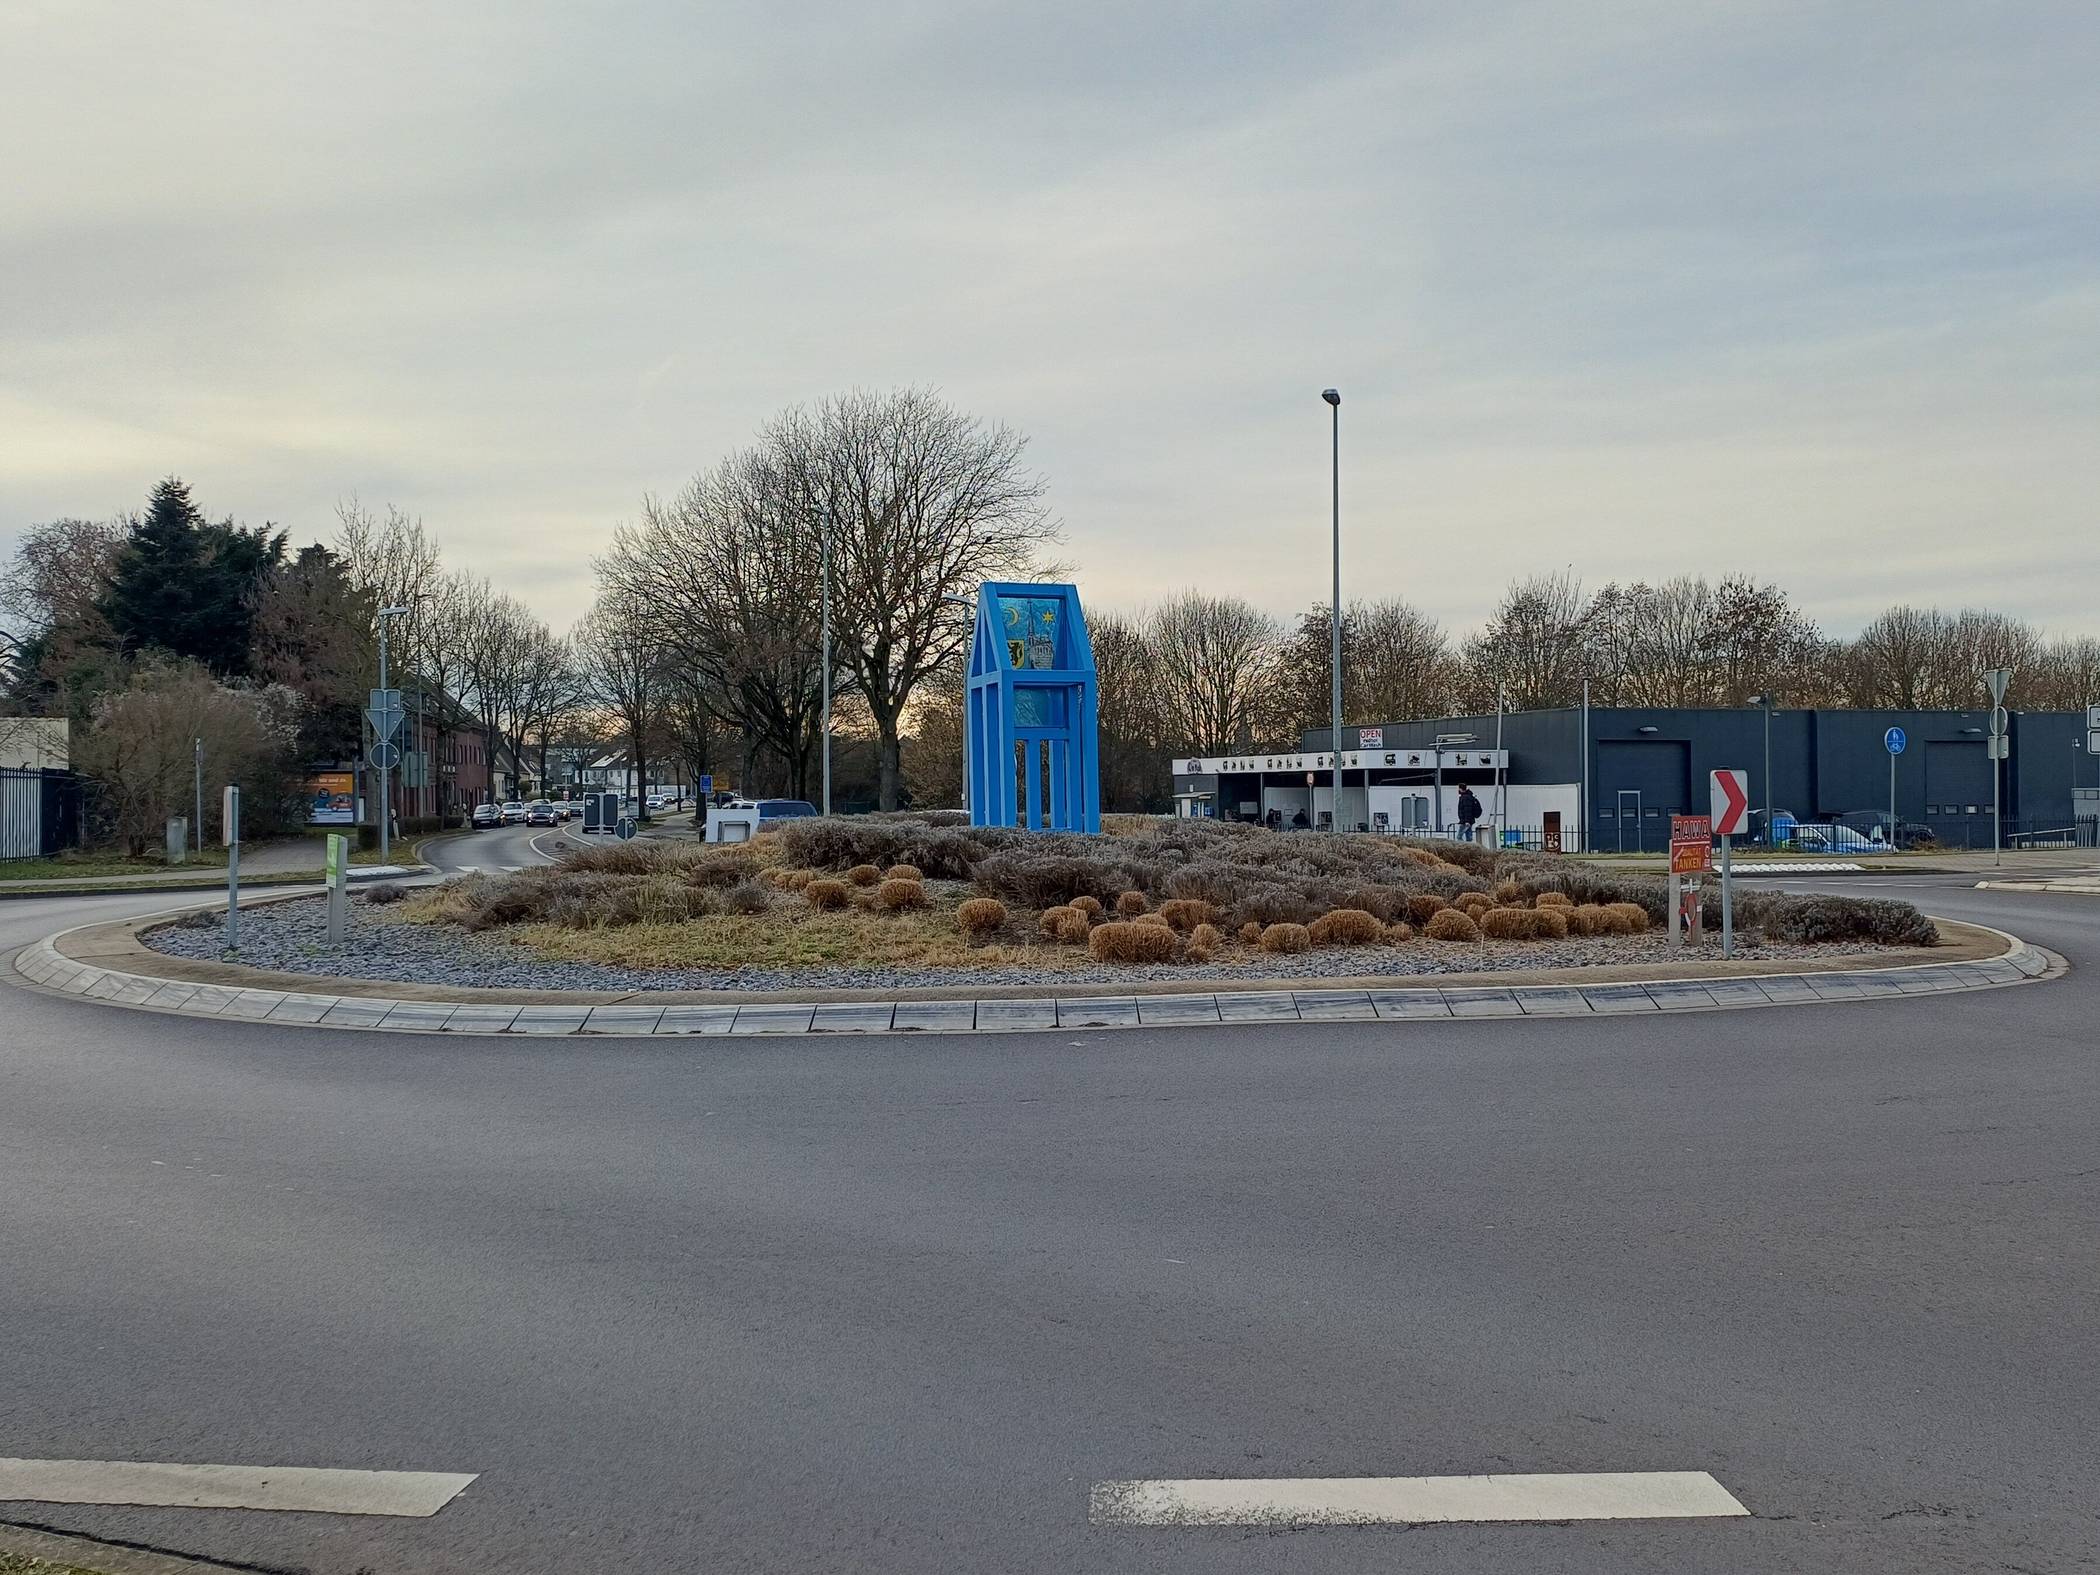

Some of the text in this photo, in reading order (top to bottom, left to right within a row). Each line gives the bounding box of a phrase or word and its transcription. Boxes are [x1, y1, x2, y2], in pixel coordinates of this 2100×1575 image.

[1360, 730, 1381, 738] OPEN
[1673, 820, 1710, 840] HAWA
[1675, 857, 1702, 870] TANKEN
